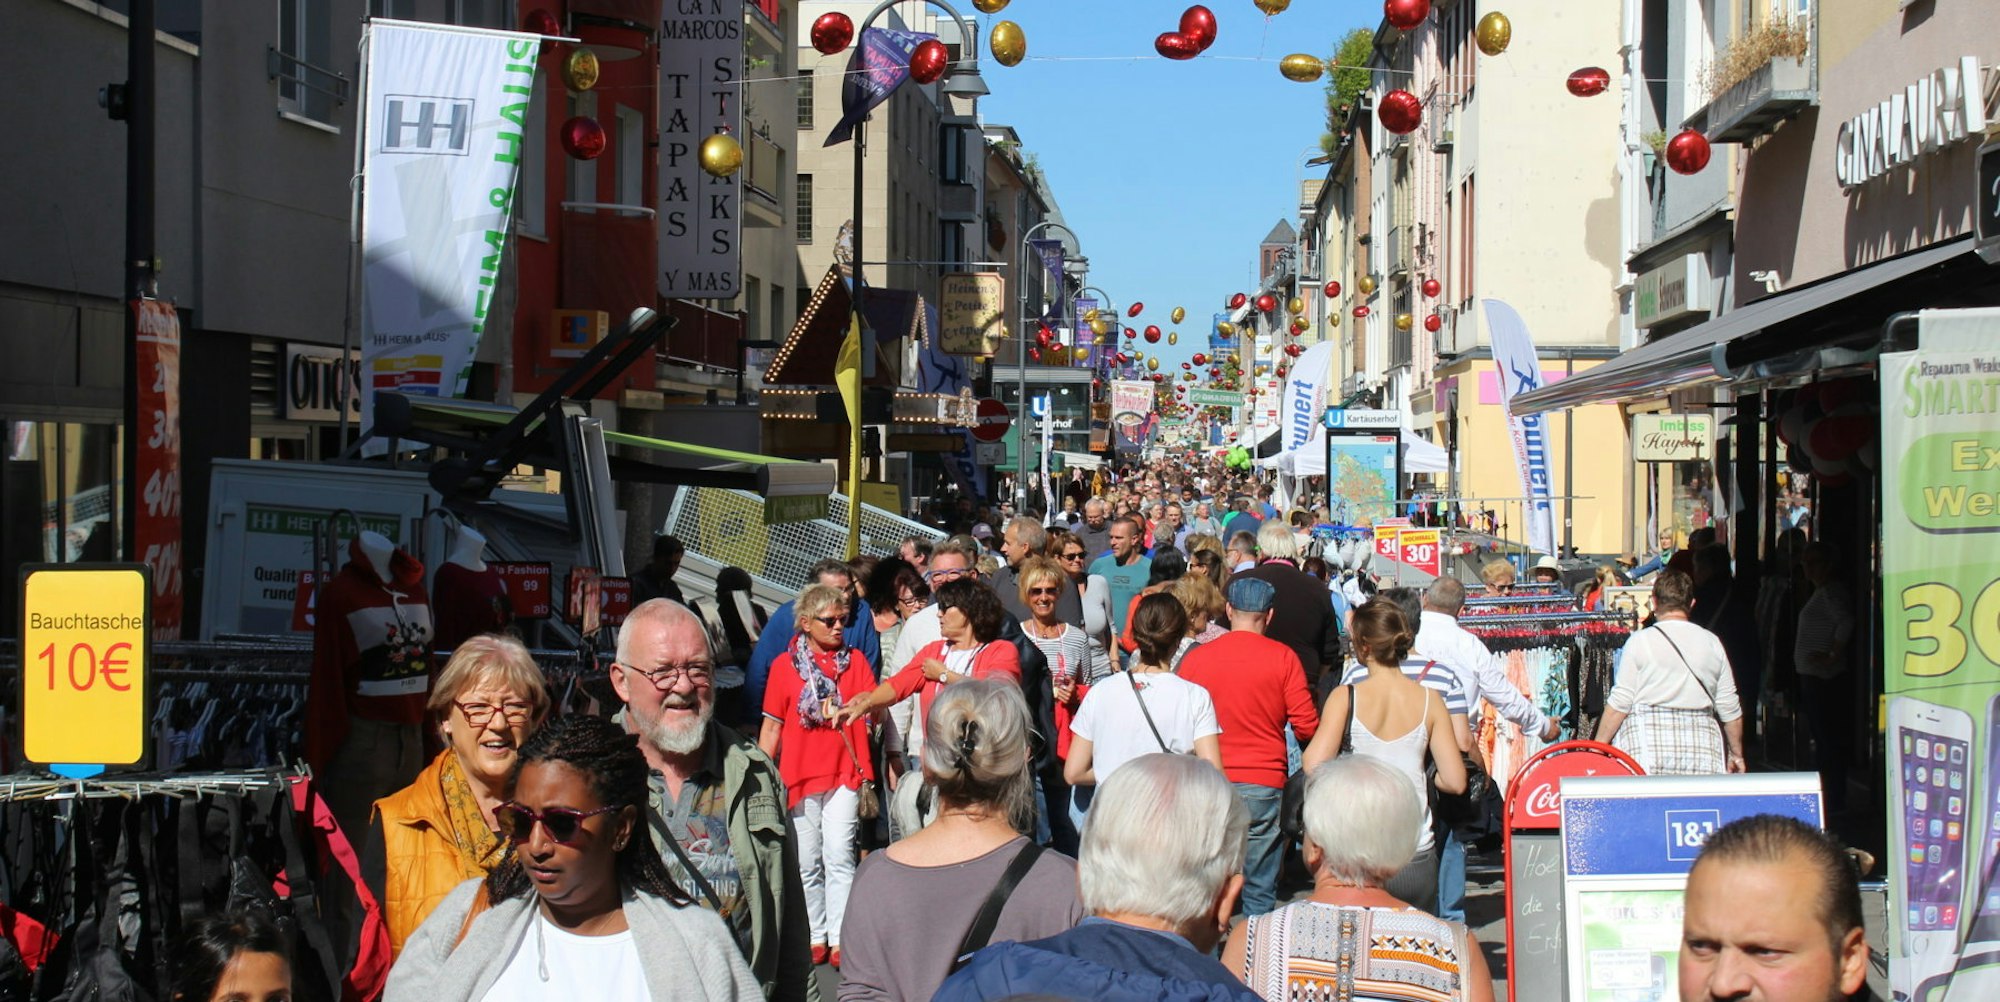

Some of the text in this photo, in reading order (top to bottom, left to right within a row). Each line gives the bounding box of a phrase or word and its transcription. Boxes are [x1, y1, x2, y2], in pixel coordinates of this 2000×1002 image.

[662, 20, 739, 40] MARCOS
[665, 74, 690, 237] TAPAS
[710, 57, 734, 255] STKS
[665, 268, 732, 291] Y MAS
[1329, 411, 1397, 426] U Kartäuserhof
[38, 642, 132, 692] 10€
[1522, 895, 1544, 917] die
